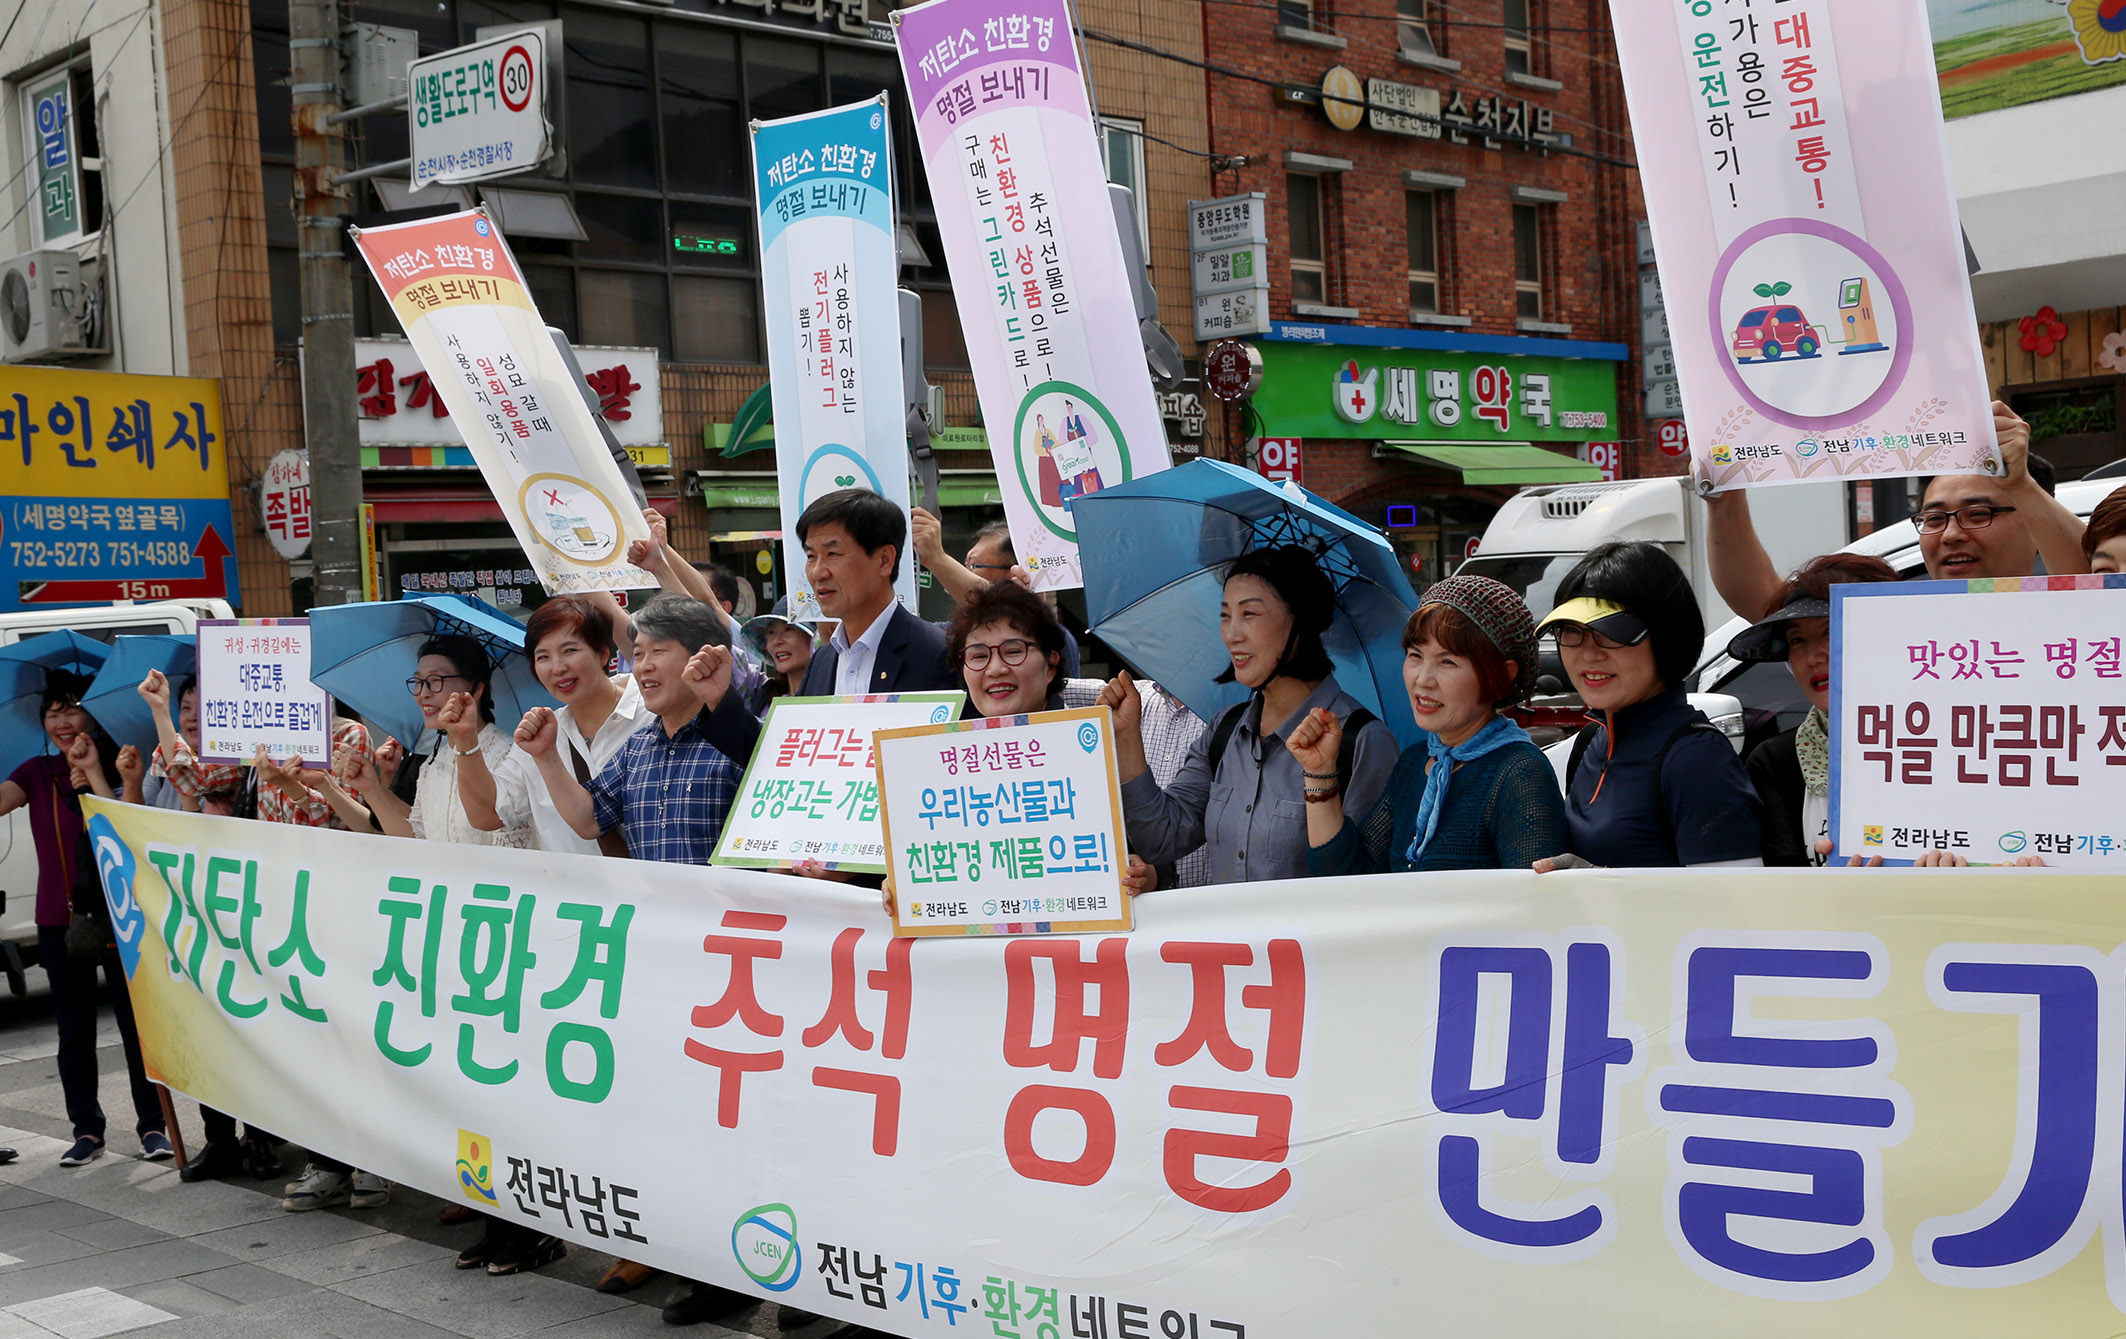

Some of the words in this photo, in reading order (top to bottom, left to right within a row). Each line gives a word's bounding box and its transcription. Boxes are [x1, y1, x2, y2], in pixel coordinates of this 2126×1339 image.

[918, 27, 979, 82] 저탄소
[984, 13, 1054, 53] 친환경
[1725, 0, 1771, 119] 가용은
[415, 58, 496, 128] 생활도로구역
[506, 63, 528, 95] 30
[936, 80, 977, 125] 명절
[980, 66, 1049, 104] 보내기
[1372, 82, 1416, 107] 사단법인
[1774, 12, 1831, 209] 대중교통!
[1445, 90, 1559, 157] 순천지부
[1692, 32, 1740, 208] 운전하기!
[767, 149, 815, 188] 저탄소
[821, 143, 877, 179] 친환경
[775, 188, 806, 223] 명절
[811, 183, 867, 215] 보내기
[1197, 203, 1250, 229] 중앙무도학원
[383, 248, 434, 280] 저탄소
[434, 243, 495, 271] 친환경
[965, 135, 992, 206] 구매는
[983, 217, 1031, 392] 그린카드로!
[989, 132, 1026, 233] 친환경
[1015, 244, 1054, 381] 상품으로!
[1030, 192, 1070, 315] 추석선물은
[1210, 254, 1229, 269] 밀알
[405, 283, 441, 310] 명절
[440, 279, 500, 301] 보내기
[1211, 270, 1230, 283] 치과
[833, 262, 853, 359] 사용하지
[1204, 315, 1232, 329] 커피숍
[799, 307, 813, 377] 뽑기!
[813, 269, 838, 408] 전기플러그
[1221, 354, 1236, 373] 원
[447, 334, 492, 407] 사용하지
[486, 413, 519, 463] 않기!
[476, 357, 531, 439] 일회용품
[499, 353, 526, 387] 성묘
[520, 394, 539, 412] 갈
[532, 416, 552, 432] 때
[840, 367, 857, 414] 않는
[1383, 365, 1552, 432] 세명약국
[0, 393, 216, 471] 마인쇄사
[1157, 392, 1206, 436] 피숍
[1262, 439, 1298, 481] 약
[1661, 424, 1686, 451] 약
[1734, 444, 1783, 460] 전라남도
[266, 487, 311, 541] 족발
[10, 542, 101, 567] 752-5273
[108, 541, 190, 566] 751-4588
[1040, 556, 1068, 568] 전라남도
[240, 664, 286, 694] 대중교통,
[1907, 638, 2025, 681] 맛있는
[2043, 636, 2122, 680] 명절
[206, 699, 238, 729] 친환경
[242, 700, 285, 729] 운전으로
[288, 702, 322, 731] 즐겁게
[218, 741, 242, 752] 전라남도
[776, 728, 863, 767] 플러그는
[939, 738, 1046, 775] 명절선물은
[1857, 701, 1938, 785] 먹을
[1951, 704, 2086, 787] 만큼만
[750, 779, 832, 819] 냉장고는
[919, 777, 1076, 830] 우리농산물과
[744, 839, 779, 852] 전라남도
[804, 840, 885, 856] 전남기후·환경네트워
[906, 839, 981, 883] 친환경
[990, 832, 1109, 880] 제품으로!
[1891, 827, 1970, 849] 전라남도
[2034, 833, 2126, 855] 전남기후·
[926, 902, 968, 917] 전라남도
[148, 849, 328, 1023] 저탄소
[373, 876, 636, 1104] 친환경
[684, 910, 916, 1158] 추석
[1003, 937, 1306, 1214] 명절
[506, 1155, 648, 1245] 전라남도
[753, 1240, 782, 1260] JCEN
